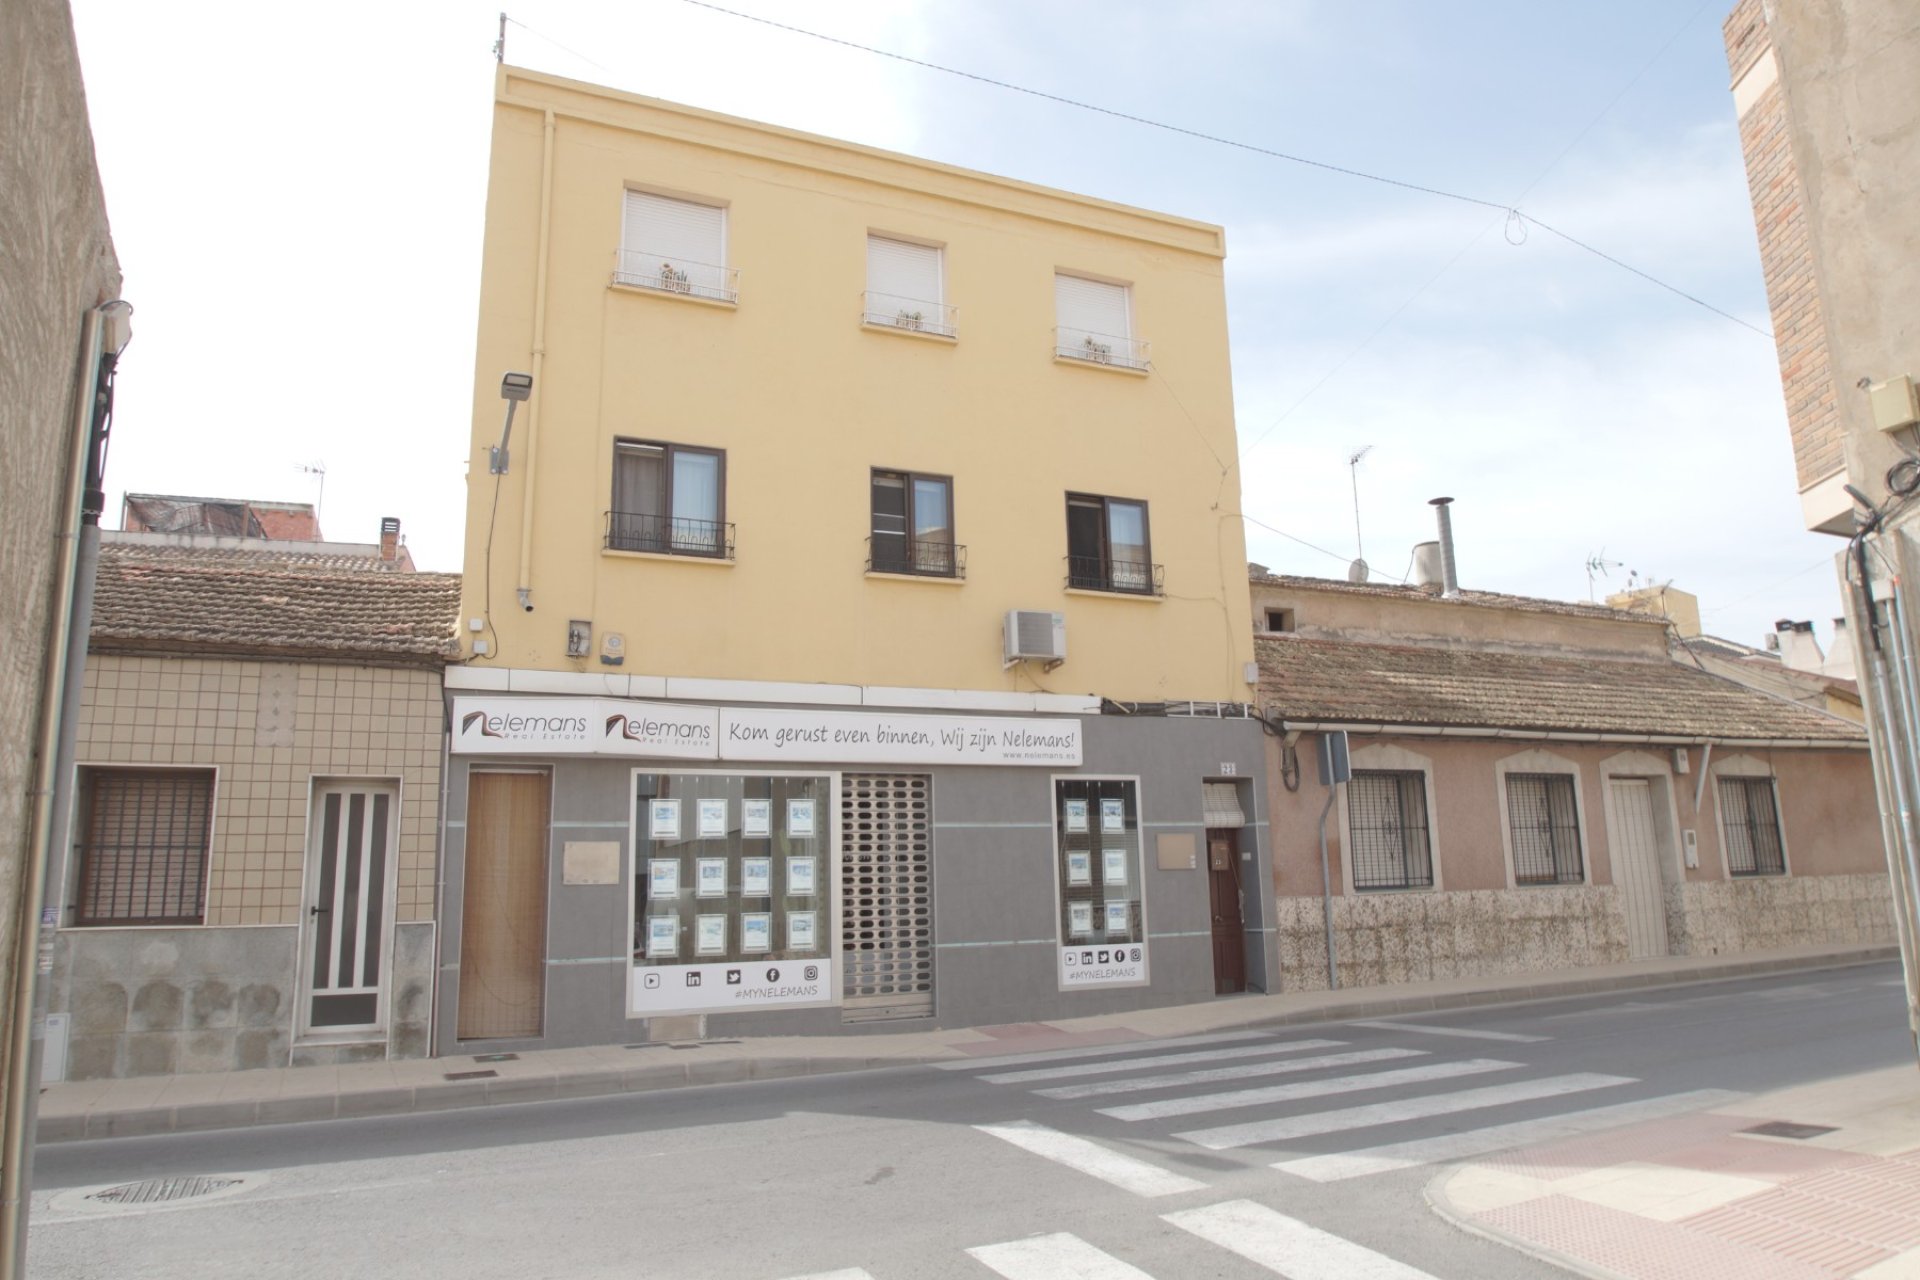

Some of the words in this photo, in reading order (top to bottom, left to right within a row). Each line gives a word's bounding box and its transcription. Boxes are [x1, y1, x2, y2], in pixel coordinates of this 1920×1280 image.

[504, 732, 534, 740] Real
[542, 732, 586, 740] Estate
[642, 736, 667, 745] Real
[674, 739, 710, 747] Estate
[729, 721, 769, 741] Kom
[774, 724, 829, 748] gerust
[834, 728, 870, 744] even
[876, 723, 935, 747] binnen,
[940, 727, 965, 752] Wij
[969, 727, 997, 753] zijn
[1002, 728, 1075, 749] Nelemans!
[1069, 966, 1137, 980] #MYNELEMANS
[734, 984, 819, 1000] #MYNELEMANS
